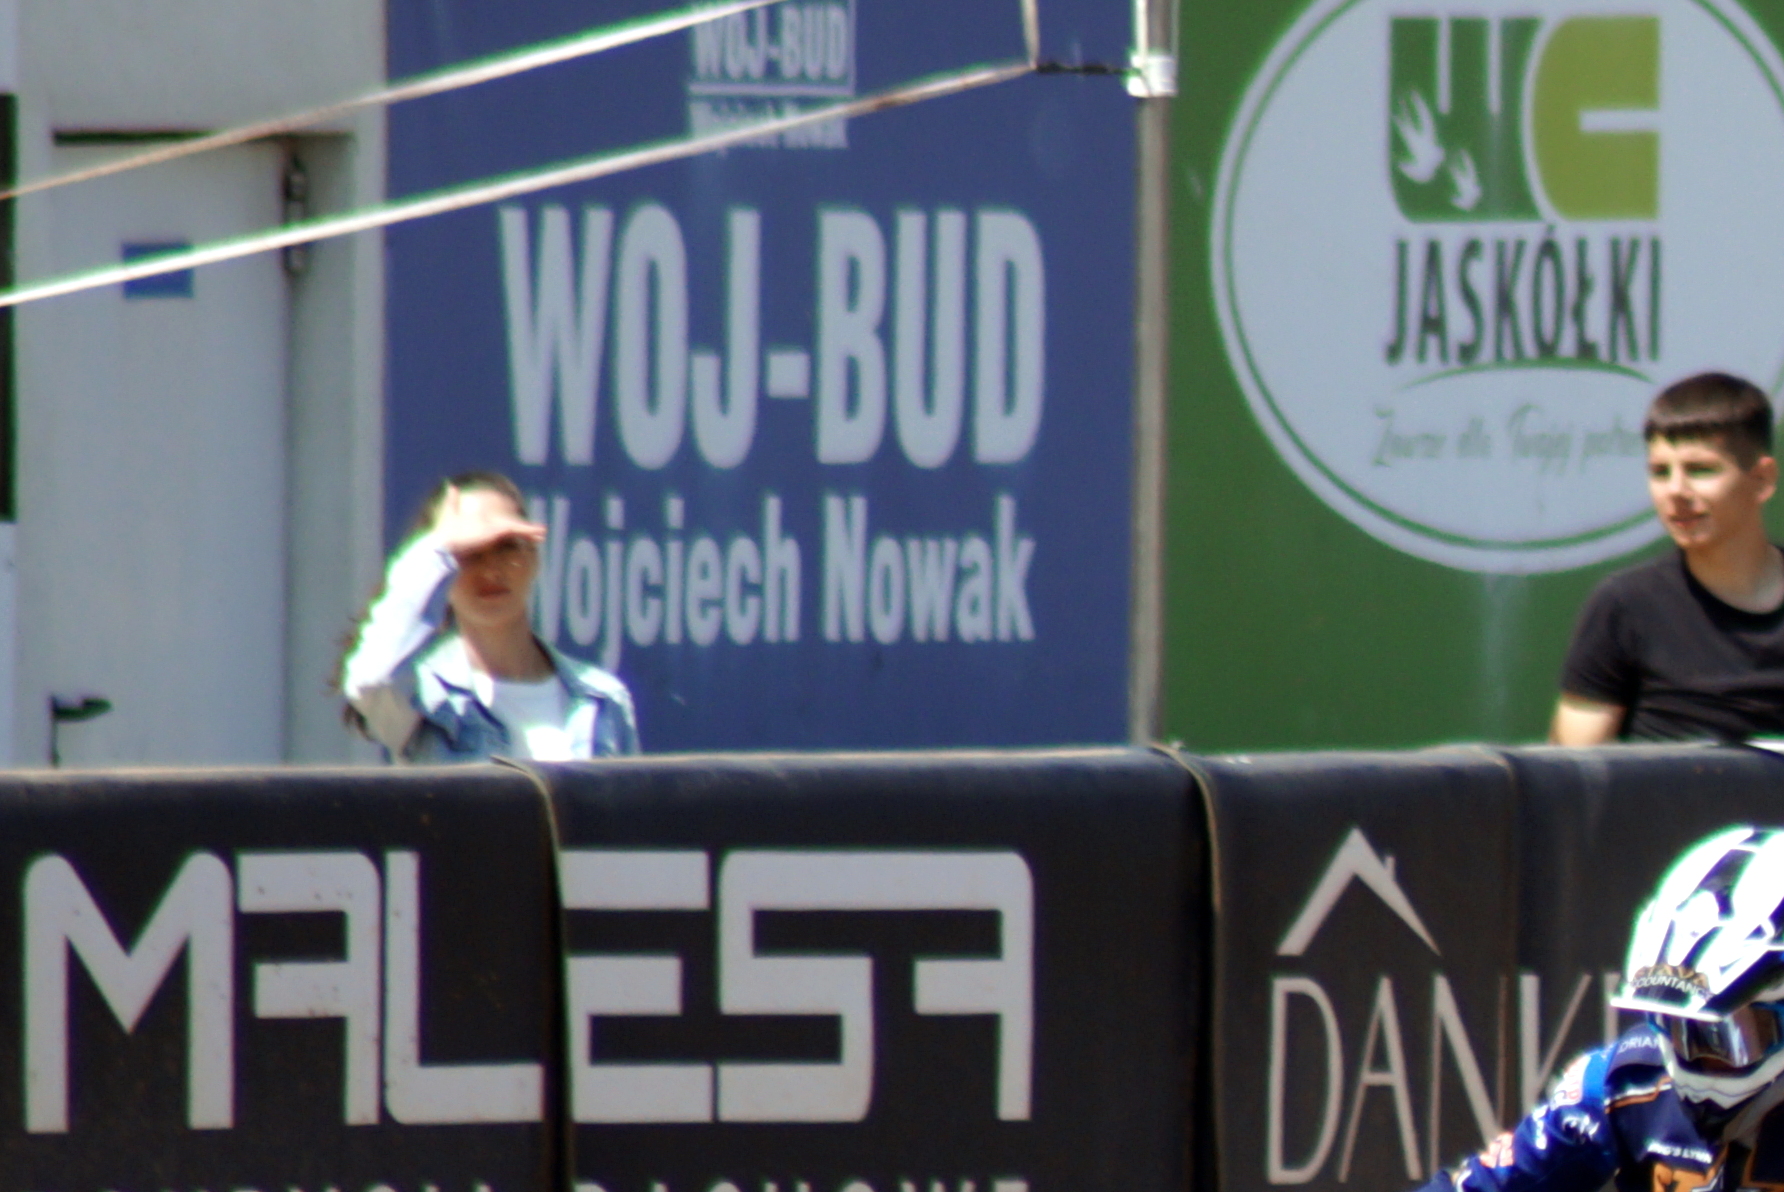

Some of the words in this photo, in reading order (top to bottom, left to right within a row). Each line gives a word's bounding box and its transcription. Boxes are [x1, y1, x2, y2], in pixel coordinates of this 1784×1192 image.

[501, 204, 1046, 469] WOJ-BUD
[1385, 224, 1662, 365] JASKÓŁKI
[530, 495, 801, 672] Wojciech
[823, 495, 1037, 644] Nowak
[24, 849, 1034, 1134] MALESA
[1267, 970, 1622, 1185] DANK
